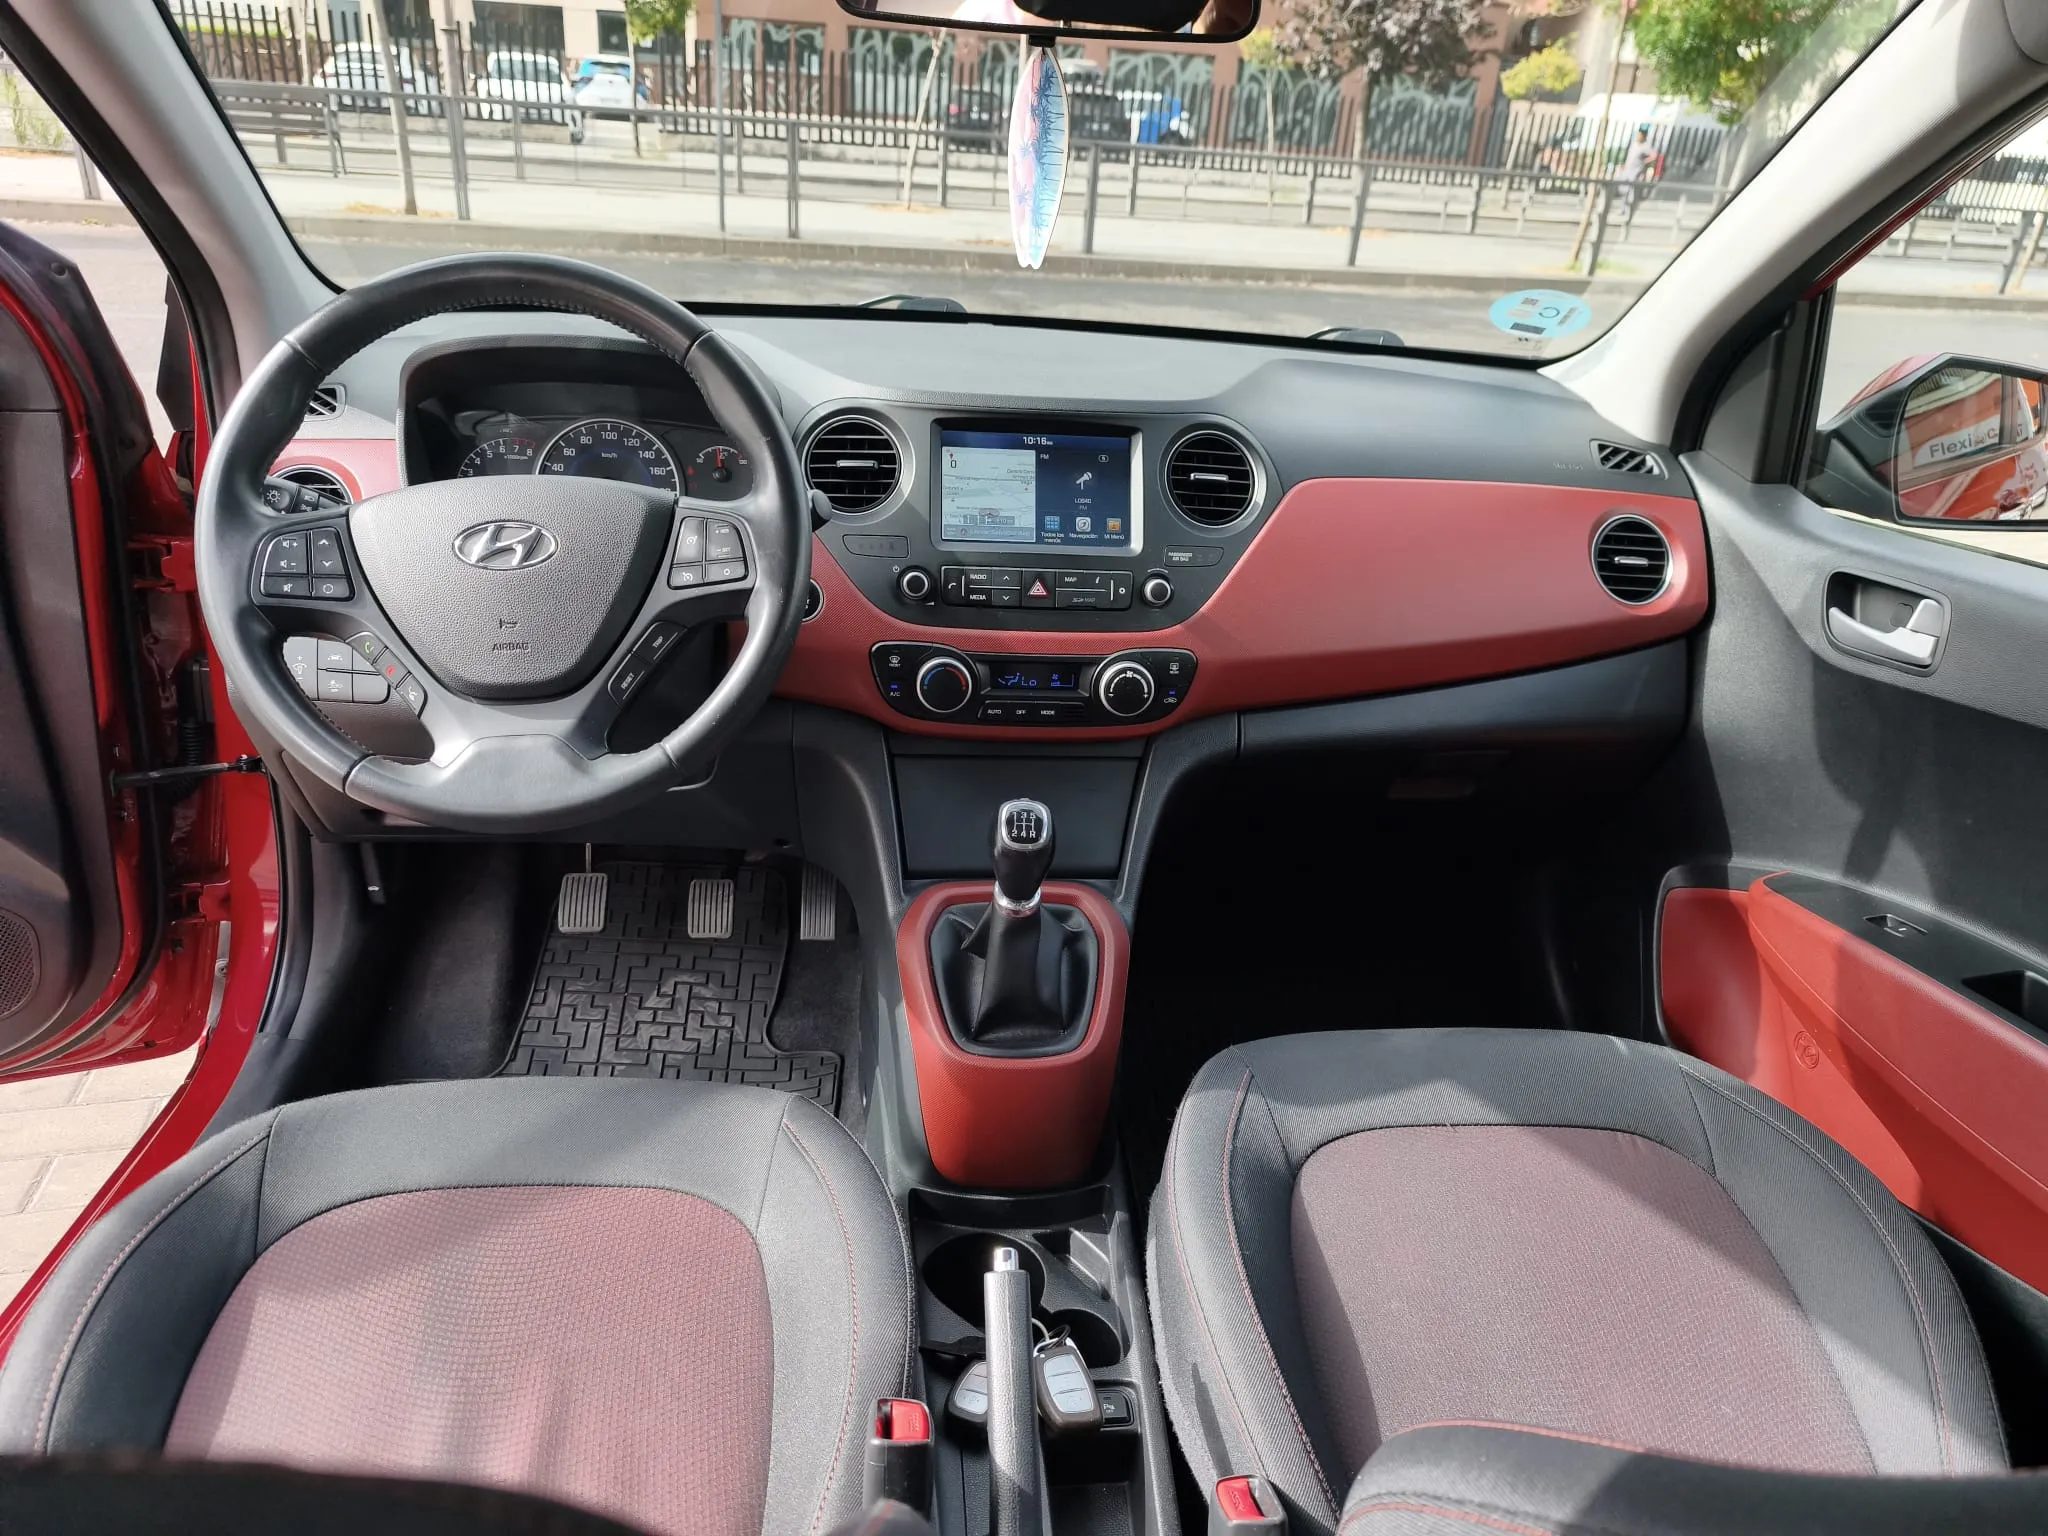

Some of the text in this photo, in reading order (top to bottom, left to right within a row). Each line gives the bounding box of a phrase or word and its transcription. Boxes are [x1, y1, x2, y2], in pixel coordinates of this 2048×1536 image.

[600, 431, 618, 440] 100
[580, 436, 592, 445] 80
[623, 438, 640, 447] 120
[1022, 436, 1047, 446] 10:16
[499, 445, 506, 453] 6
[513, 445, 520, 453] 7
[526, 448, 533, 457] 8
[563, 448, 576, 457] 60
[486, 450, 493, 458] 5
[601, 451, 618, 459] km/h
[638, 450, 656, 460] 140
[551, 463, 564, 472] 40
[649, 466, 666, 476] 160
[492, 642, 530, 651] AIRBAG
[620, 672, 635, 690] RESET
